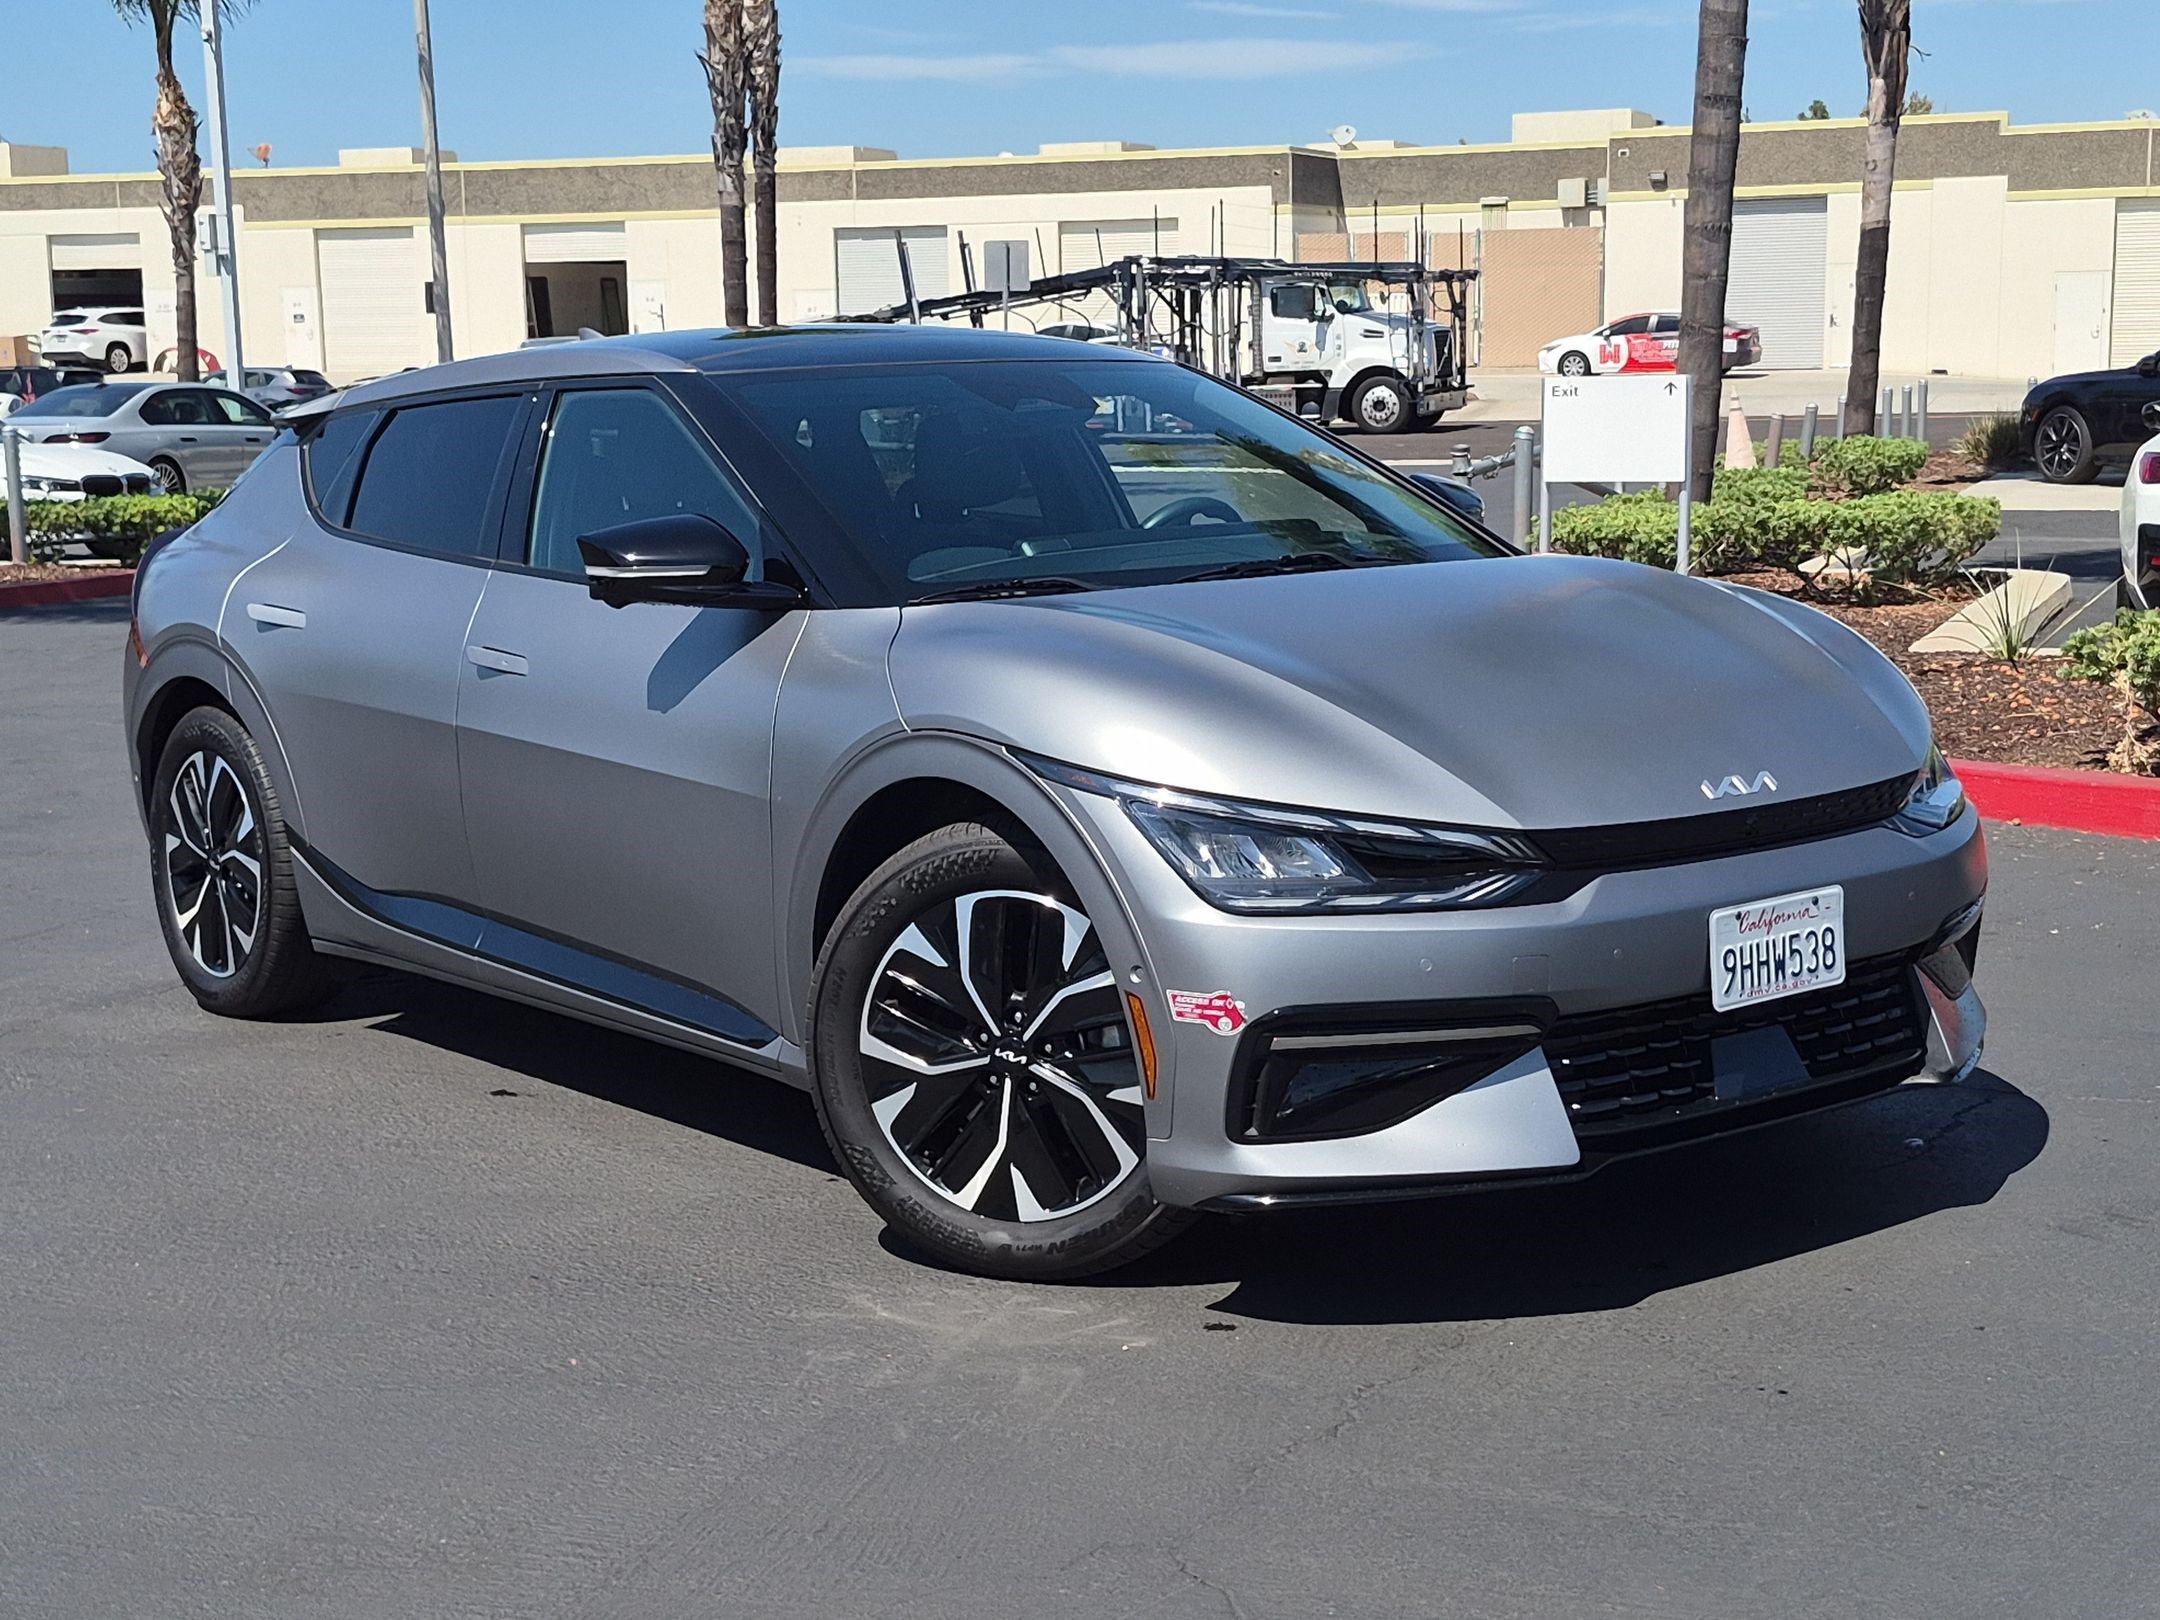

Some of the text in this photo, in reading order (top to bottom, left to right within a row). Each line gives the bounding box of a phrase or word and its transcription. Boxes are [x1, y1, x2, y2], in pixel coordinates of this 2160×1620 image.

[1552, 385, 1578, 397] Exit
[1738, 905, 1818, 936] California
[1722, 926, 1837, 996] 9HHW538
[1746, 978, 1813, 998] dmv.ca.gov
